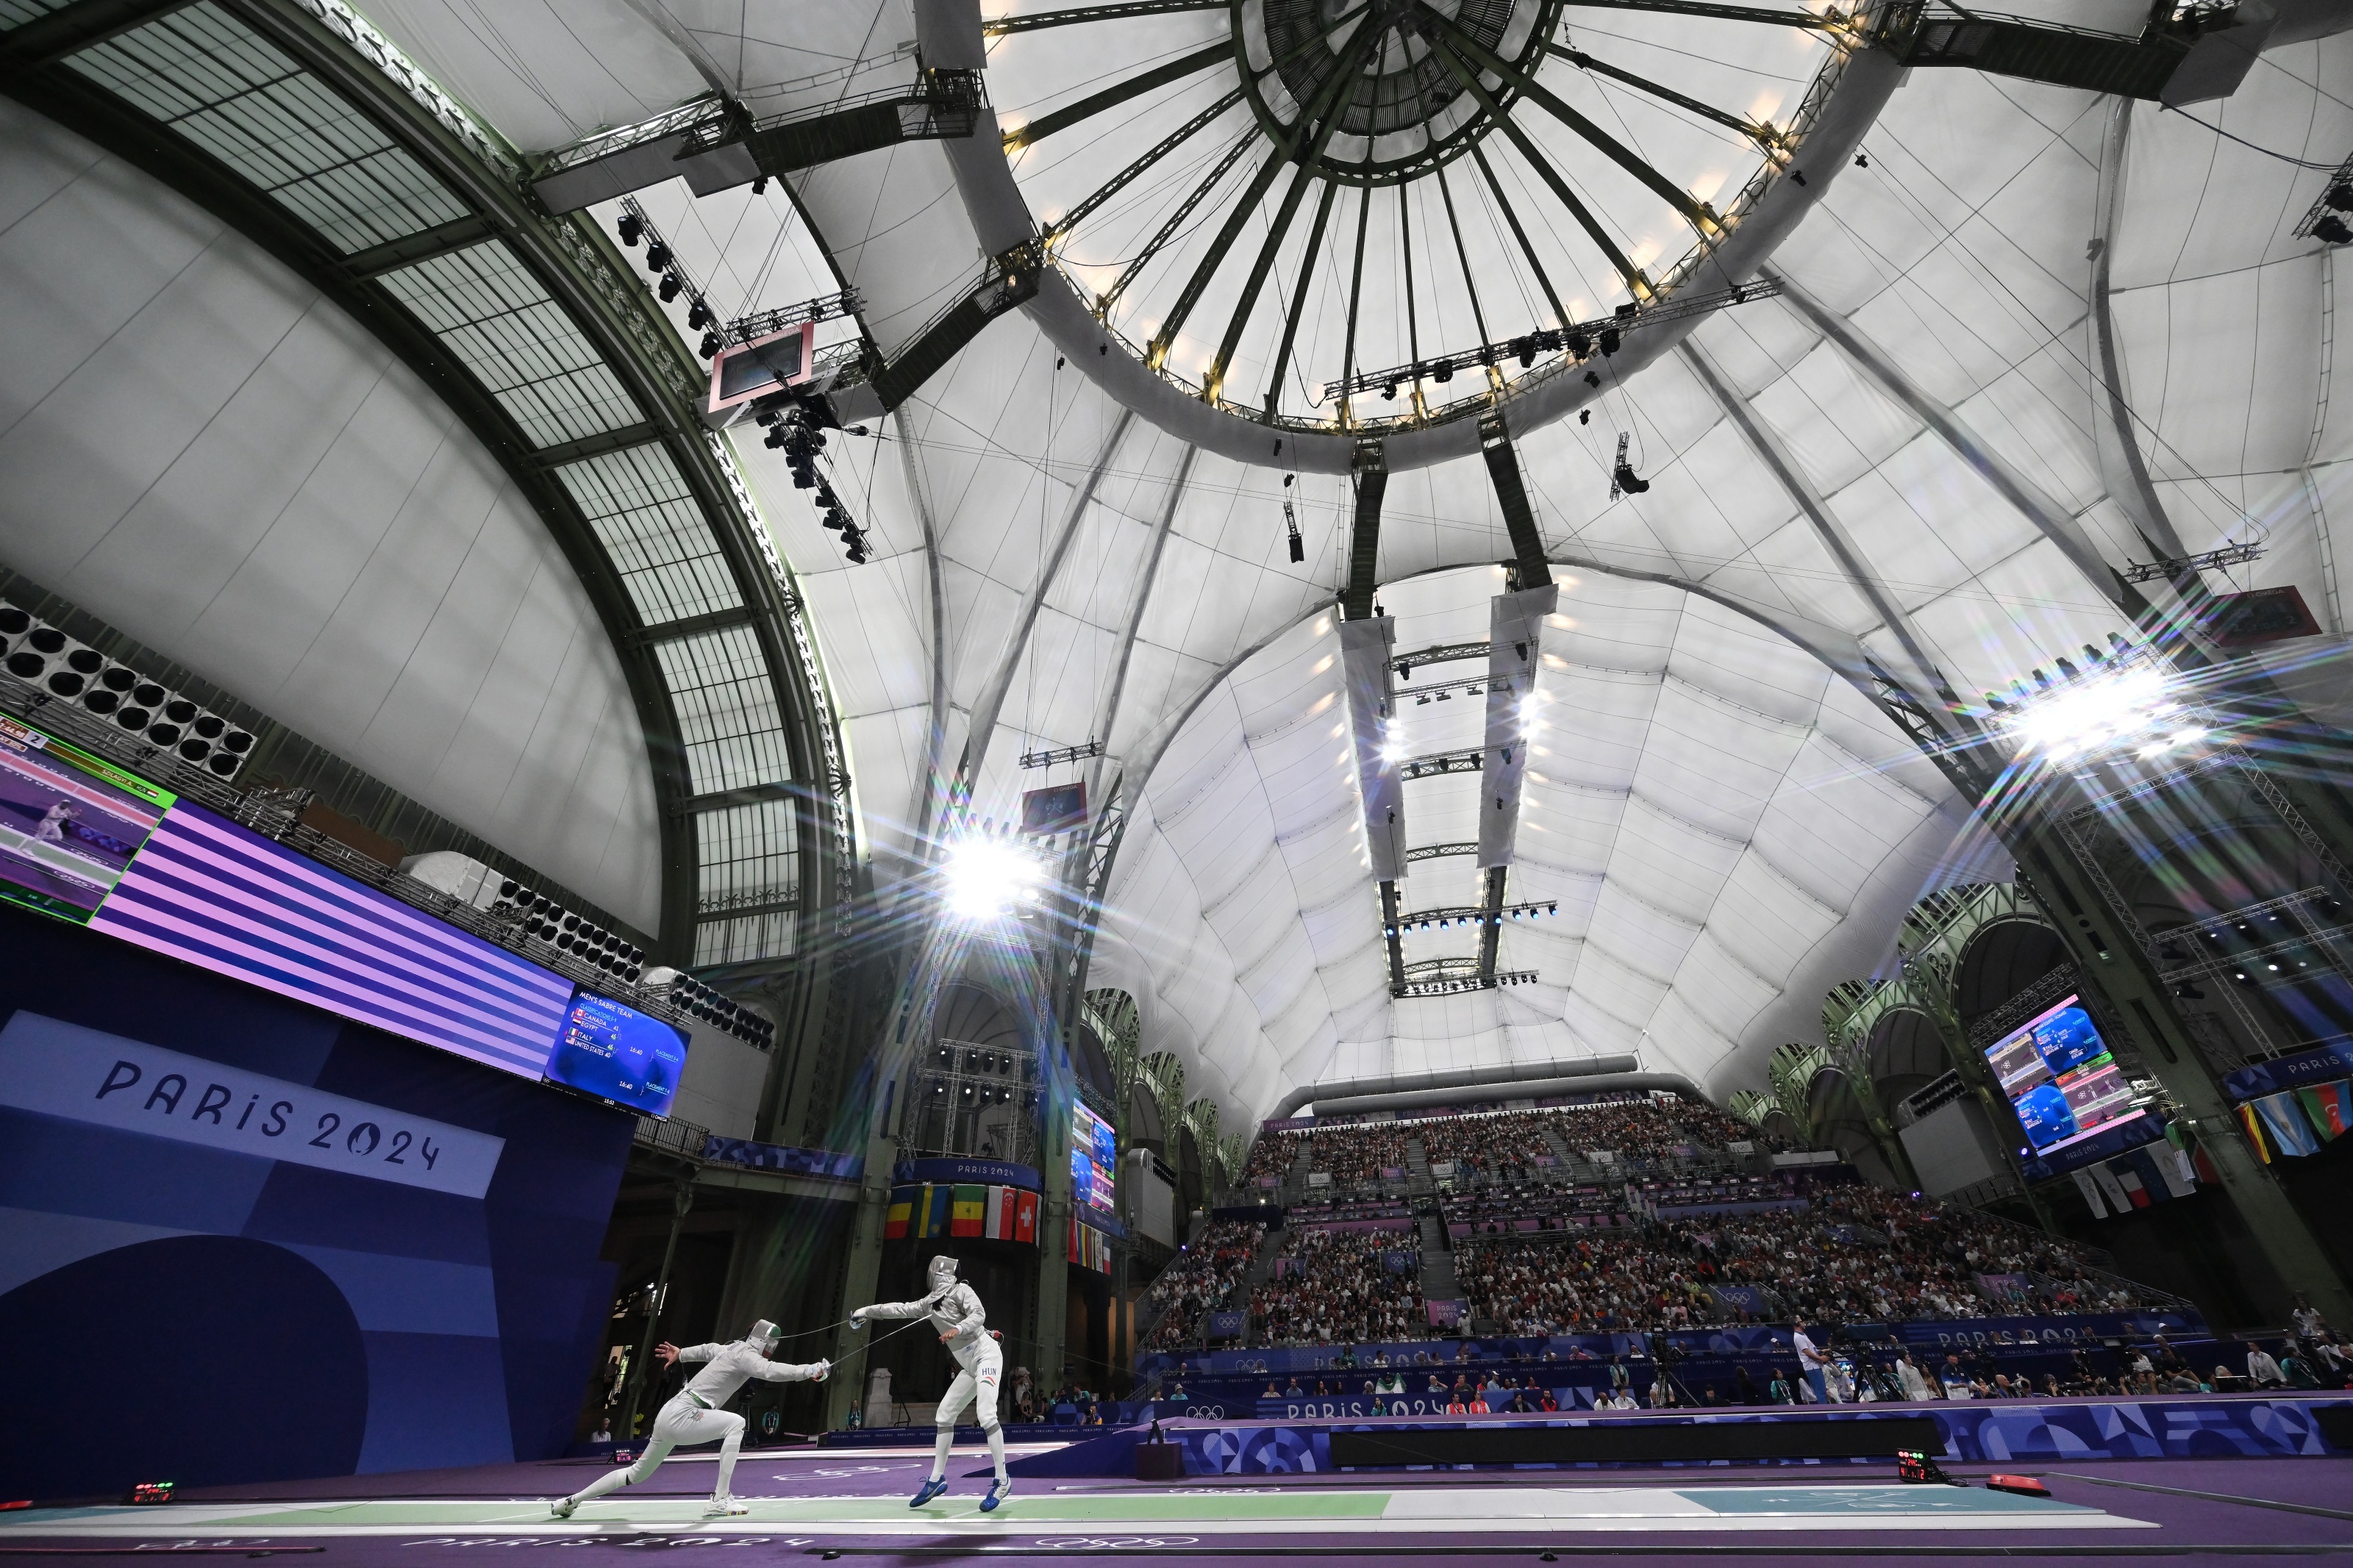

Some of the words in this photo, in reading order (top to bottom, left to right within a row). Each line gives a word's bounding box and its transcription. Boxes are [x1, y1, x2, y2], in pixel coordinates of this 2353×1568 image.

[772, 327, 800, 340] OMEGA
[2255, 589, 2285, 598] OMEGA
[30, 735, 40, 744] 2
[135, 785, 147, 793] HUN
[579, 991, 598, 1004] MEN'S
[599, 999, 617, 1012] SABRE
[618, 1007, 632, 1019] TEAM
[584, 1012, 607, 1026] CANADA
[581, 1020, 599, 1032] EGYPT
[578, 1031, 593, 1042] ITALY
[574, 1040, 590, 1050] UNITED
[589, 1045, 604, 1056] STATES
[629, 1046, 643, 1056] 16:40
[655, 1049, 674, 1059] PLACEMENT
[619, 1081, 633, 1089] 16:40
[646, 1081, 665, 1092] PLACEMENT
[308, 1113, 440, 1171] 2024
[2083, 1143, 2099, 1154] 2024
[991, 1167, 1013, 1176] 2024
[982, 1367, 996, 1376] HUN
[1382, 1400, 1444, 1417] 024
[1920, 1469, 1925, 1480] 2
[618, 1538, 814, 1546] 2024
